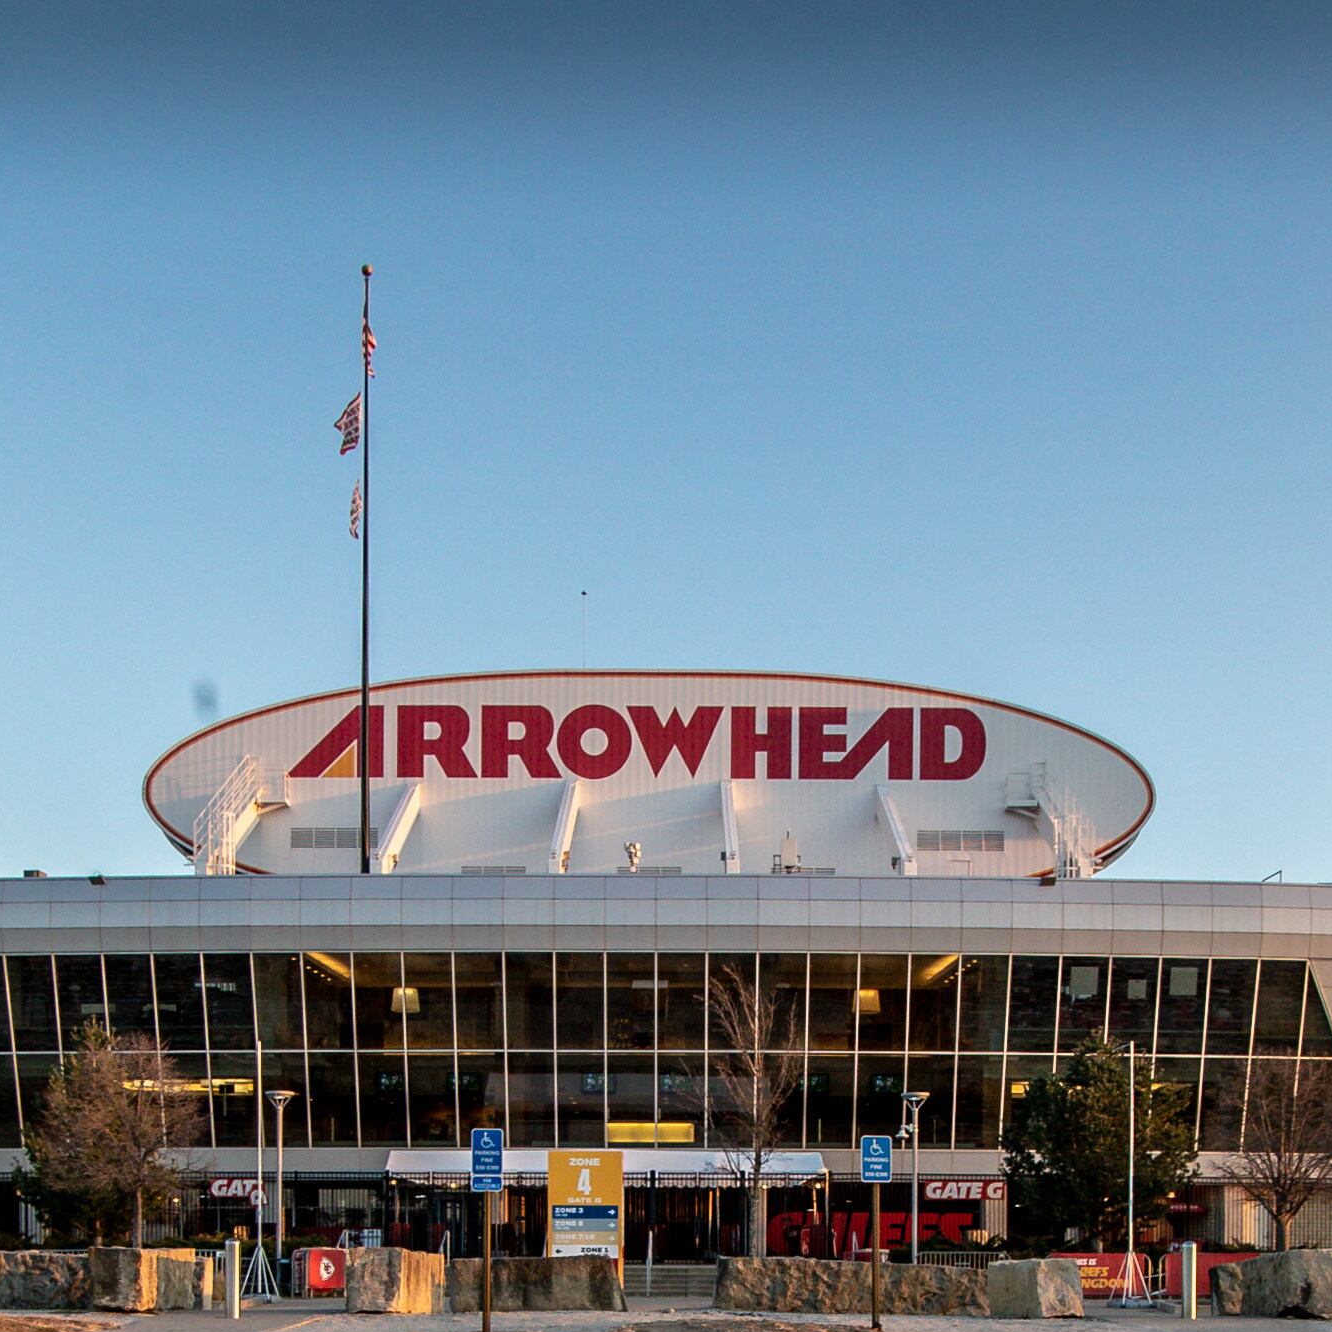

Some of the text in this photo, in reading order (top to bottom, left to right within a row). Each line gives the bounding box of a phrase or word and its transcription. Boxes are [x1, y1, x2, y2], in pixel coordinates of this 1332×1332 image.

[288, 704, 987, 780] ARROWHEAD
[569, 1158, 600, 1166] ZONE
[211, 1179, 263, 1197] GAT
[577, 1168, 591, 1195] 4
[925, 1182, 1004, 1199] GATE G
